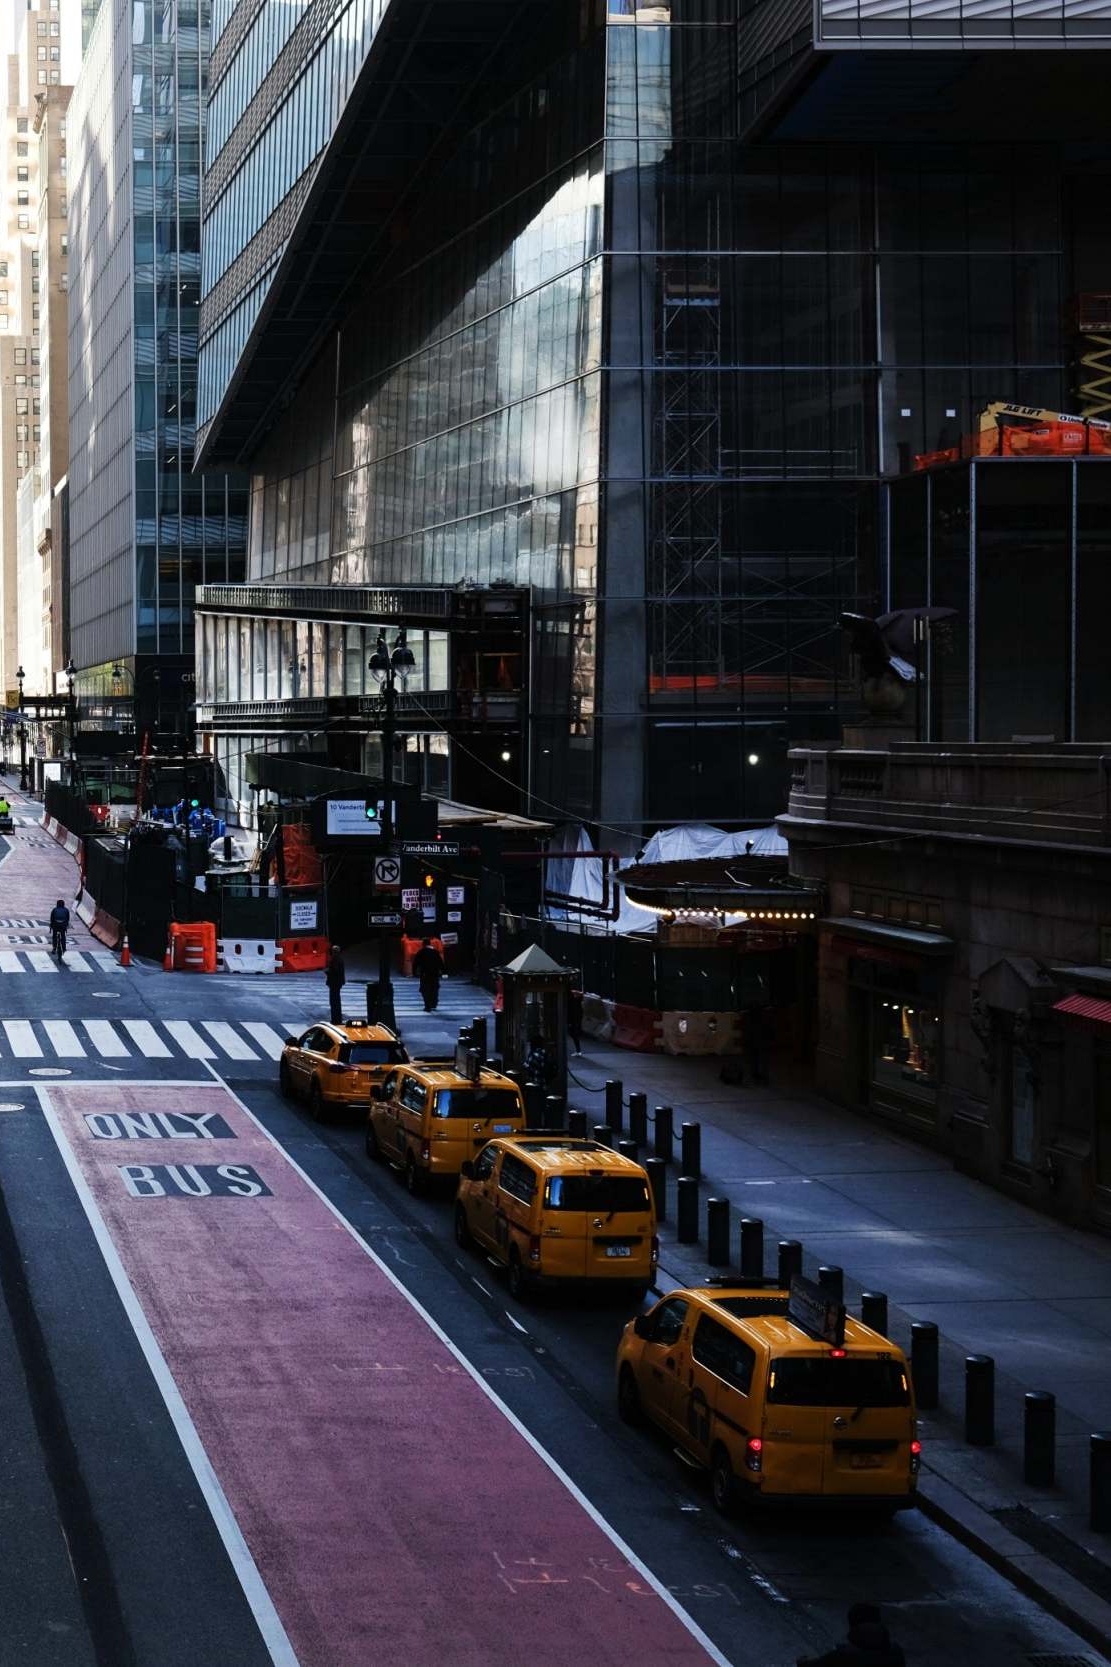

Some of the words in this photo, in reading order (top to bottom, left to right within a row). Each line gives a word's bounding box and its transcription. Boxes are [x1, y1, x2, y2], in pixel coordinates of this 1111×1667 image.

[1022, 407, 1042, 416] LIFT
[180, 671, 196, 682] cit
[442, 845, 458, 854] Ave
[84, 1112, 217, 1139] ONLY
[119, 1164, 263, 1197] BUS
